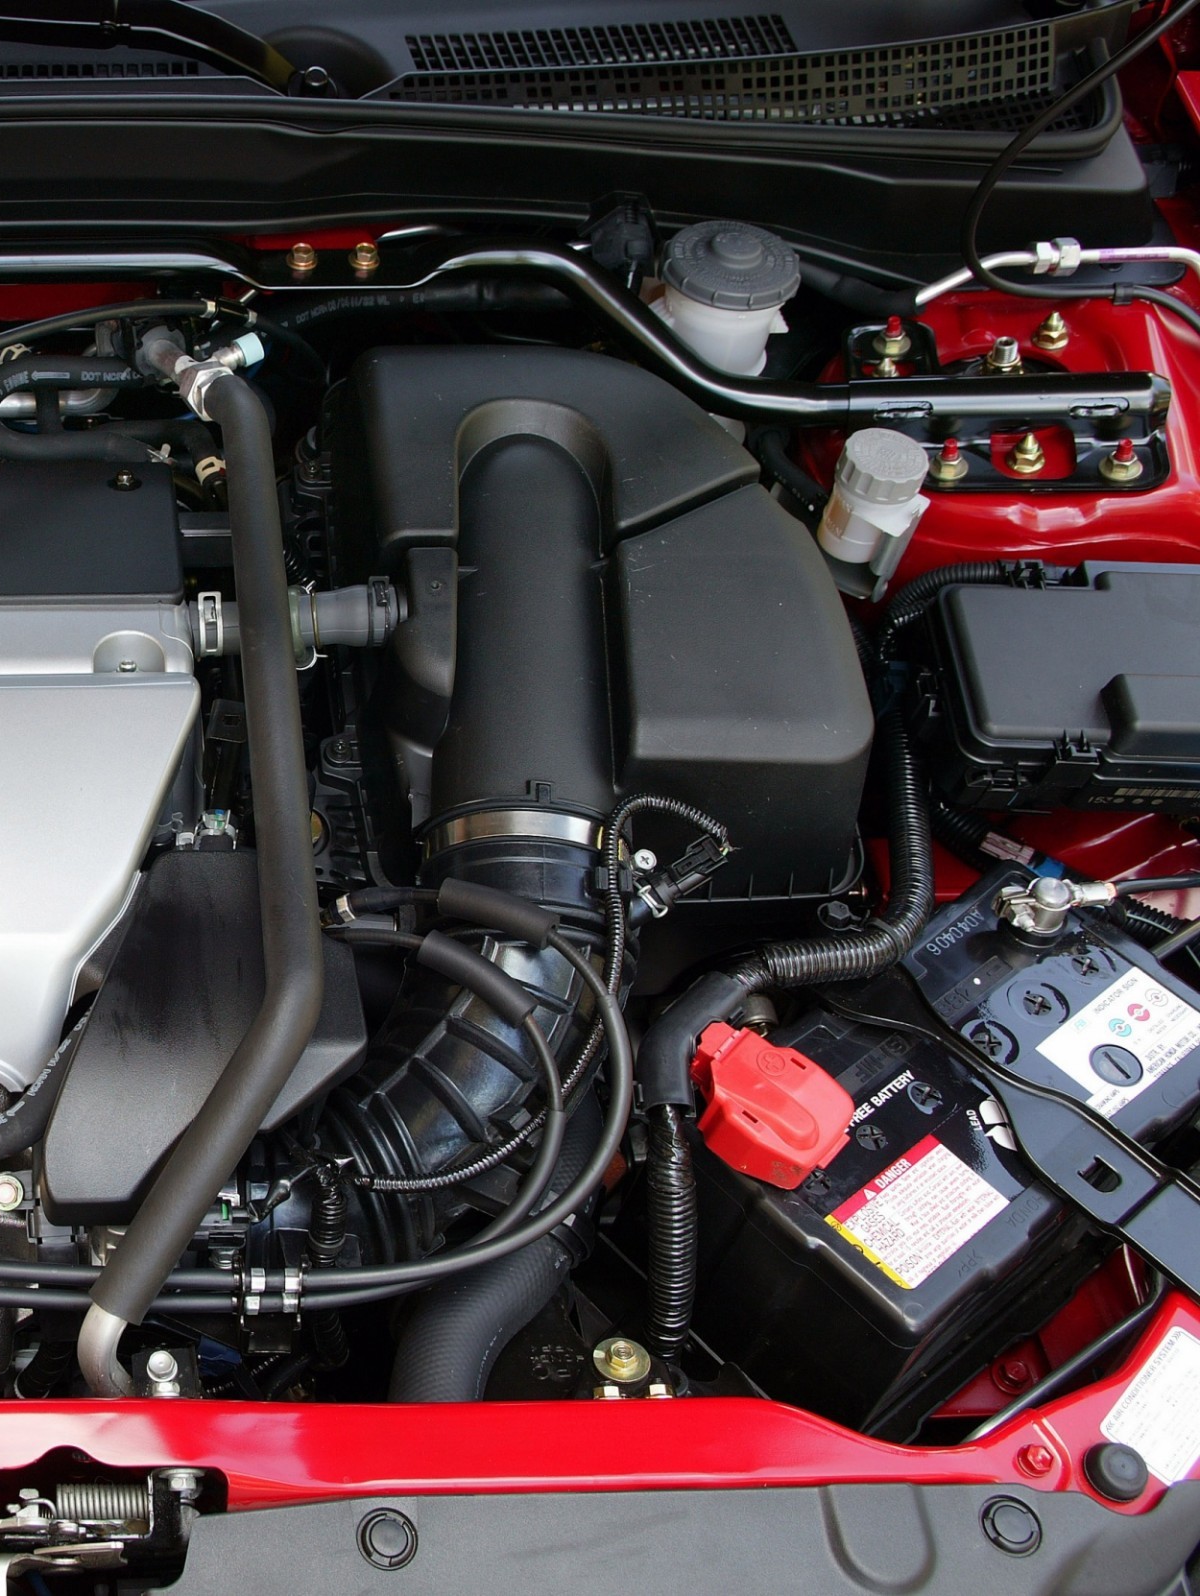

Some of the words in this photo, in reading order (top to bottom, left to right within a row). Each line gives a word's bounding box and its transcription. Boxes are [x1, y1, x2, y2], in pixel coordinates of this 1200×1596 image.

[81, 371, 101, 381] DOT
[869, 1069, 916, 1108] BATTERY
[966, 1108, 983, 1132] LEAD
[875, 1158, 912, 1189] DANGER
[895, 1251, 923, 1275] POISON
[1113, 1409, 1124, 1422] AIR
[1121, 1364, 1157, 1410] CONDITIONER
[1153, 1339, 1176, 1366] SYSTEM
